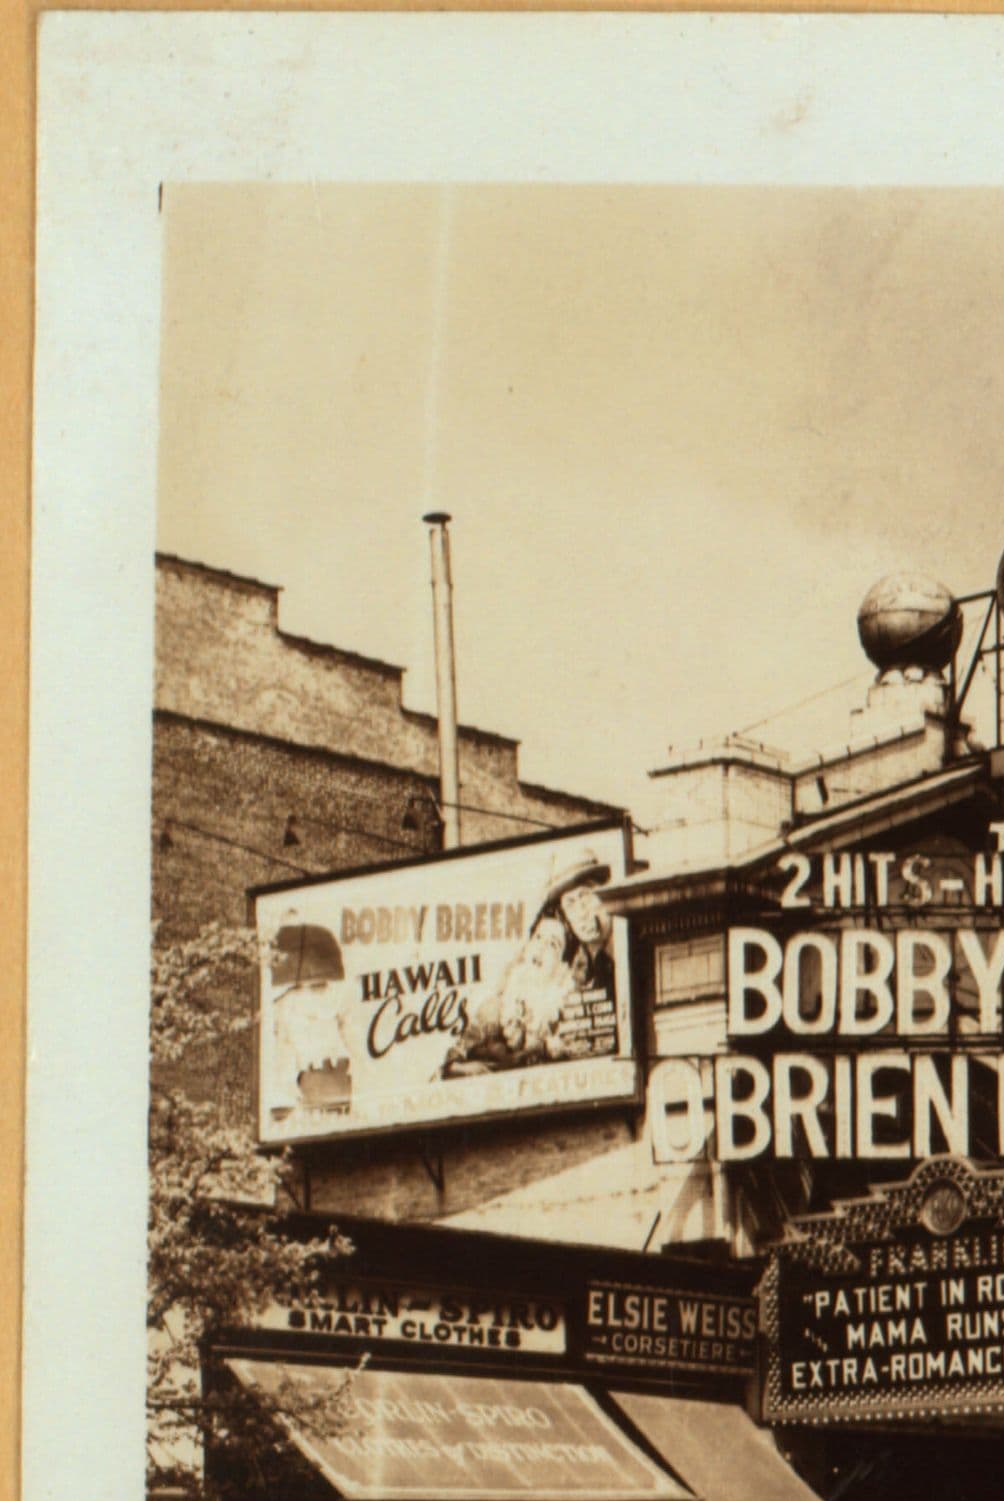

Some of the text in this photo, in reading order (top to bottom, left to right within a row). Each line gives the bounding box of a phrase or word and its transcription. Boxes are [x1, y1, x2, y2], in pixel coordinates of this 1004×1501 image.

[341, 901, 526, 945] BOBBY BREEN
[360, 953, 482, 1003] HAWAII
[367, 988, 470, 1060] Calls
[940, 1278, 965, 1307] IN
[288, 1309, 522, 1349] SMART CLOTHES
[587, 1290, 669, 1332] ELSIE
[678, 1299, 757, 1340] WEISS
[846, 1317, 928, 1350] MAMA
[611, 1332, 736, 1362] CORSETIERE
